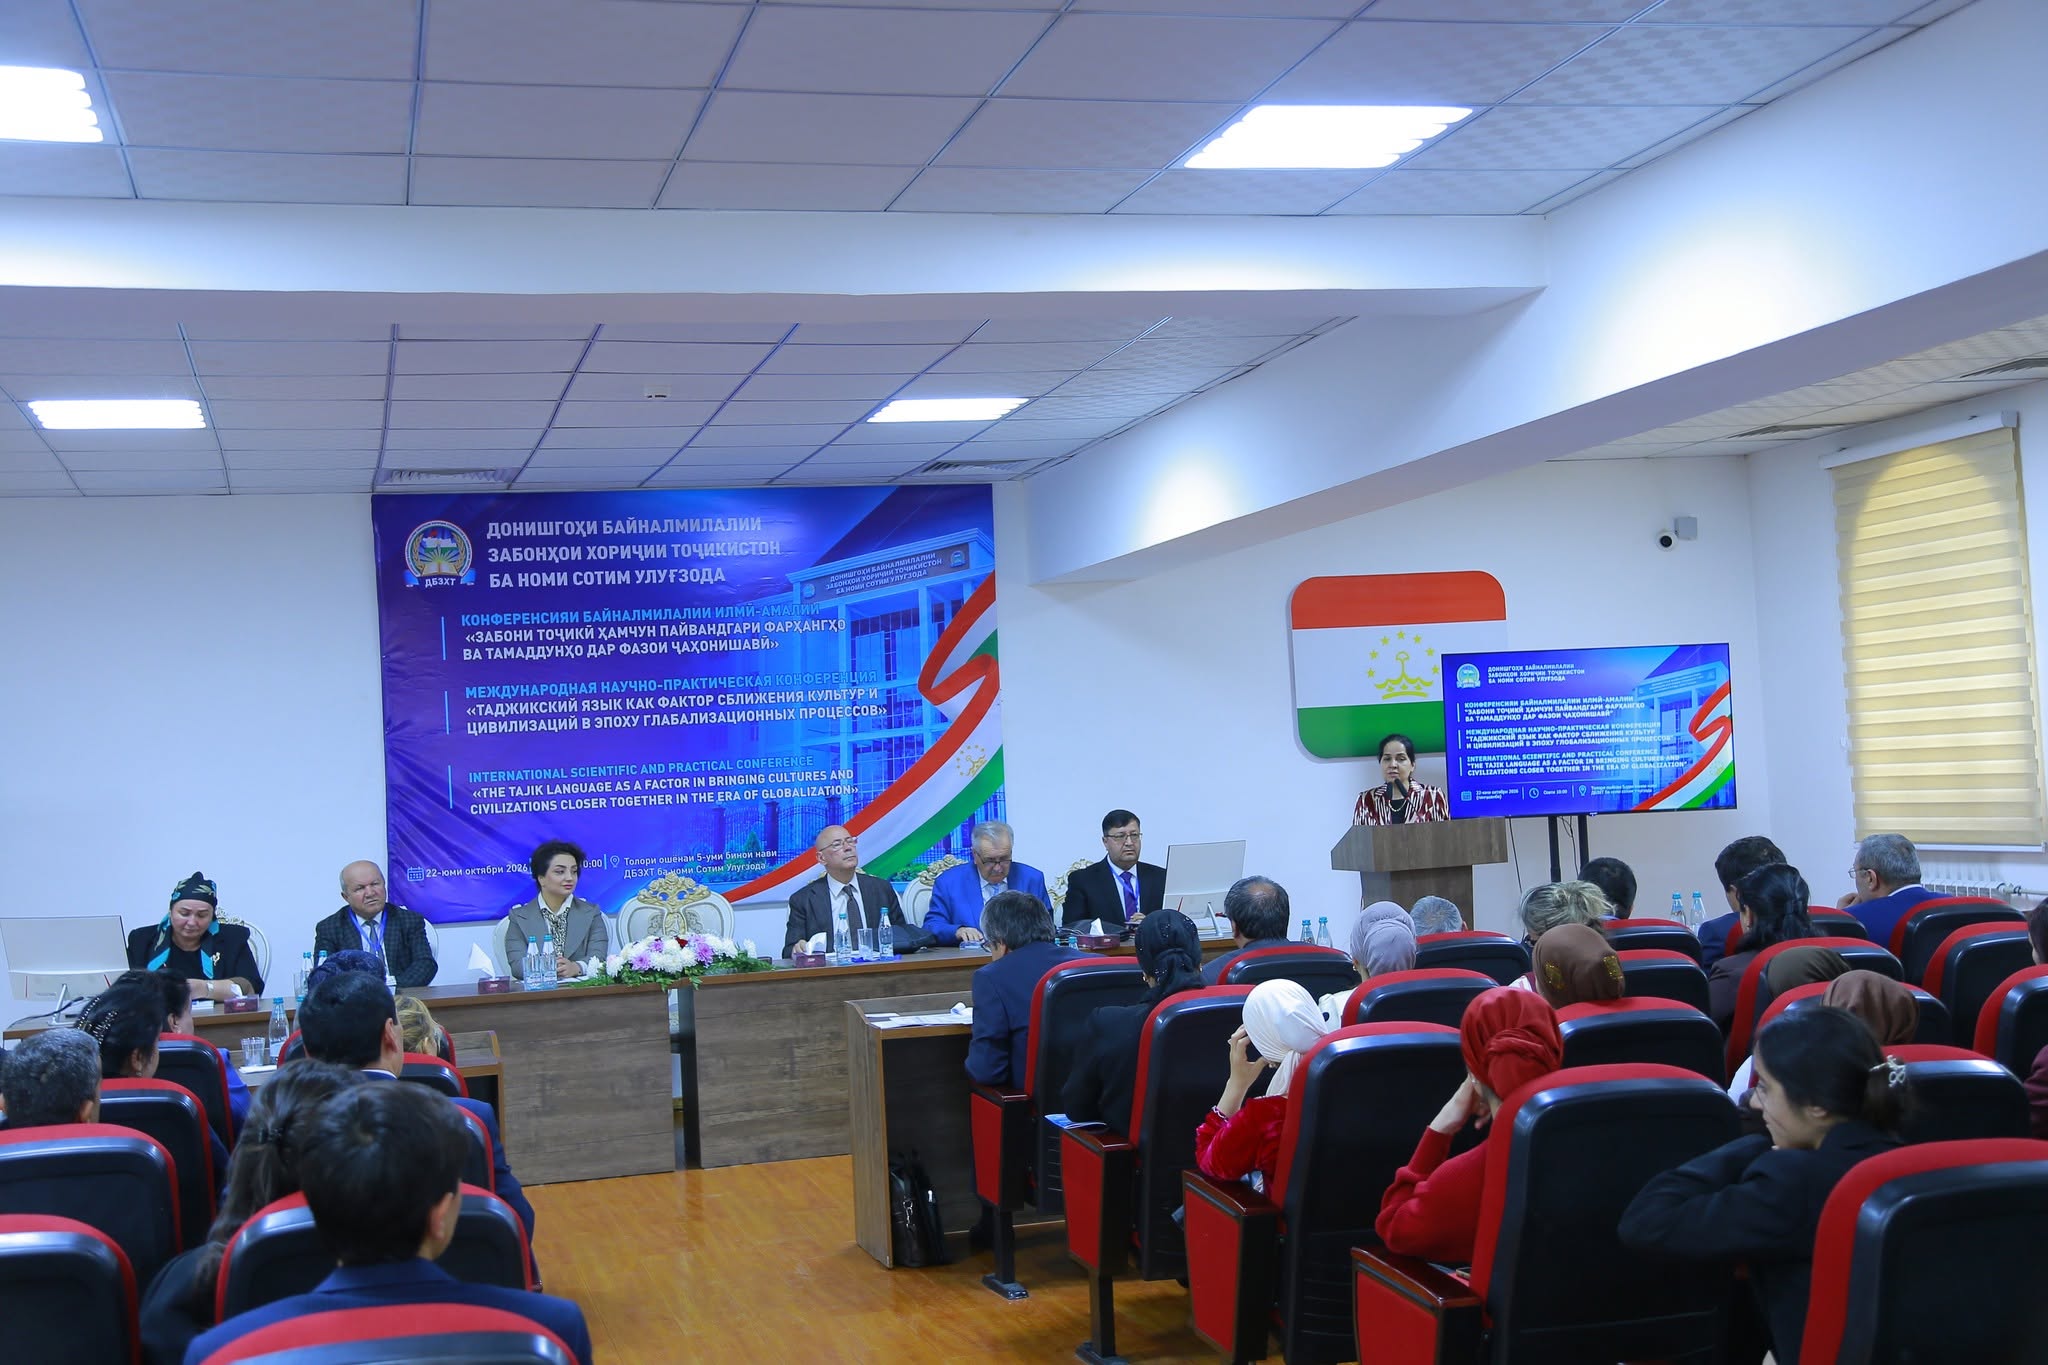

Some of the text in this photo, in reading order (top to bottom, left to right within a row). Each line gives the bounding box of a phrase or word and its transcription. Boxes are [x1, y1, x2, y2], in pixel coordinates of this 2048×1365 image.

[486, 516, 761, 539] ДОНИШГОҲИ БАЙНАЛМИЛАЛИИ
[488, 541, 780, 563] ЗАБОНҲОИ ХОРИҶИИ ТОҶИКИСТОН
[425, 577, 456, 588] ДБЗХТ
[489, 567, 726, 588] БА НОМИ СОТИМ УЛУҒЗОДА
[865, 577, 890, 588] СОТИМ
[461, 610, 579, 627] КОНФЕРЕНСИЯИ
[583, 605, 712, 623] БАЙНАЛМИЛАЛИИ
[598, 625, 656, 641] ҲАМЧУН
[660, 621, 761, 637] ПАЙВАНДГАРИ
[764, 618, 846, 634] ФАРҲАНГҲО
[463, 648, 482, 661] ВА
[485, 645, 584, 660] ТАМАДДУНҲО
[587, 643, 616, 658] ДАР
[619, 641, 668, 655] ФАЗОИ
[465, 670, 878, 699] МЕЖДУНАРОДНАЯ НАУЧНО-ПРАКТИЧЕСКАЯ КОНФЕРЕНЦИЯ
[582, 698, 622, 712] ЯЗЫК
[626, 697, 654, 710] КАК
[657, 695, 713, 709] ФАКТОР
[717, 691, 804, 706] СБЛИЖЕНИЯ
[807, 688, 865, 702] КУЛЬТУР
[869, 687, 878, 699] И
[467, 715, 578, 737] ЦИВИЛИЗАЦИЙ
[582, 717, 591, 730] В
[594, 715, 640, 729] ЭПОХУ
[643, 708, 796, 727] ГЛАБАЛИЗАЦИОННЫХ
[1467, 754, 1520, 762] INTERNATIONAL
[1522, 752, 1561, 760] SCIENTIFIC
[1577, 750, 1614, 758] PRACTICAL
[1615, 748, 1658, 756] CONFERENCE
[1596, 756, 1630, 764] BRINGING
[469, 755, 814, 783] INTERNATIONAL SCIENTIFIC AND PRACTICAL CONFERENCE
[1467, 768, 1518, 776] CIVILIZATIONS
[1546, 765, 1580, 773] TOGETHER
[509, 784, 544, 797] TAJIK
[546, 782, 612, 795] LANGUAGE
[615, 780, 631, 792] AS
[633, 780, 642, 791] A
[645, 778, 690, 790] FACTOR
[693, 776, 706, 788] IN
[709, 774, 766, 787] BRINGING
[768, 771, 827, 783] CULTURES
[830, 769, 854, 780] AND
[470, 800, 558, 815] CIVILIZATIONS
[560, 797, 607, 811] CLOSER
[610, 794, 673, 808] TOGETHER
[676, 793, 688, 805] IN
[691, 792, 715, 803] THE
[717, 790, 741, 802] ERA
[744, 789, 759, 800] OF
[425, 859, 602, 878] 22-юми октябри 2026 0:00
[624, 855, 657, 867] Толори
[696, 852, 724, 863] 5-уми
[725, 851, 753, 861] бинои
[623, 868, 655, 879] ДБЗХТ
[657, 867, 668, 876] ба
[696, 864, 724, 874] Сотим
